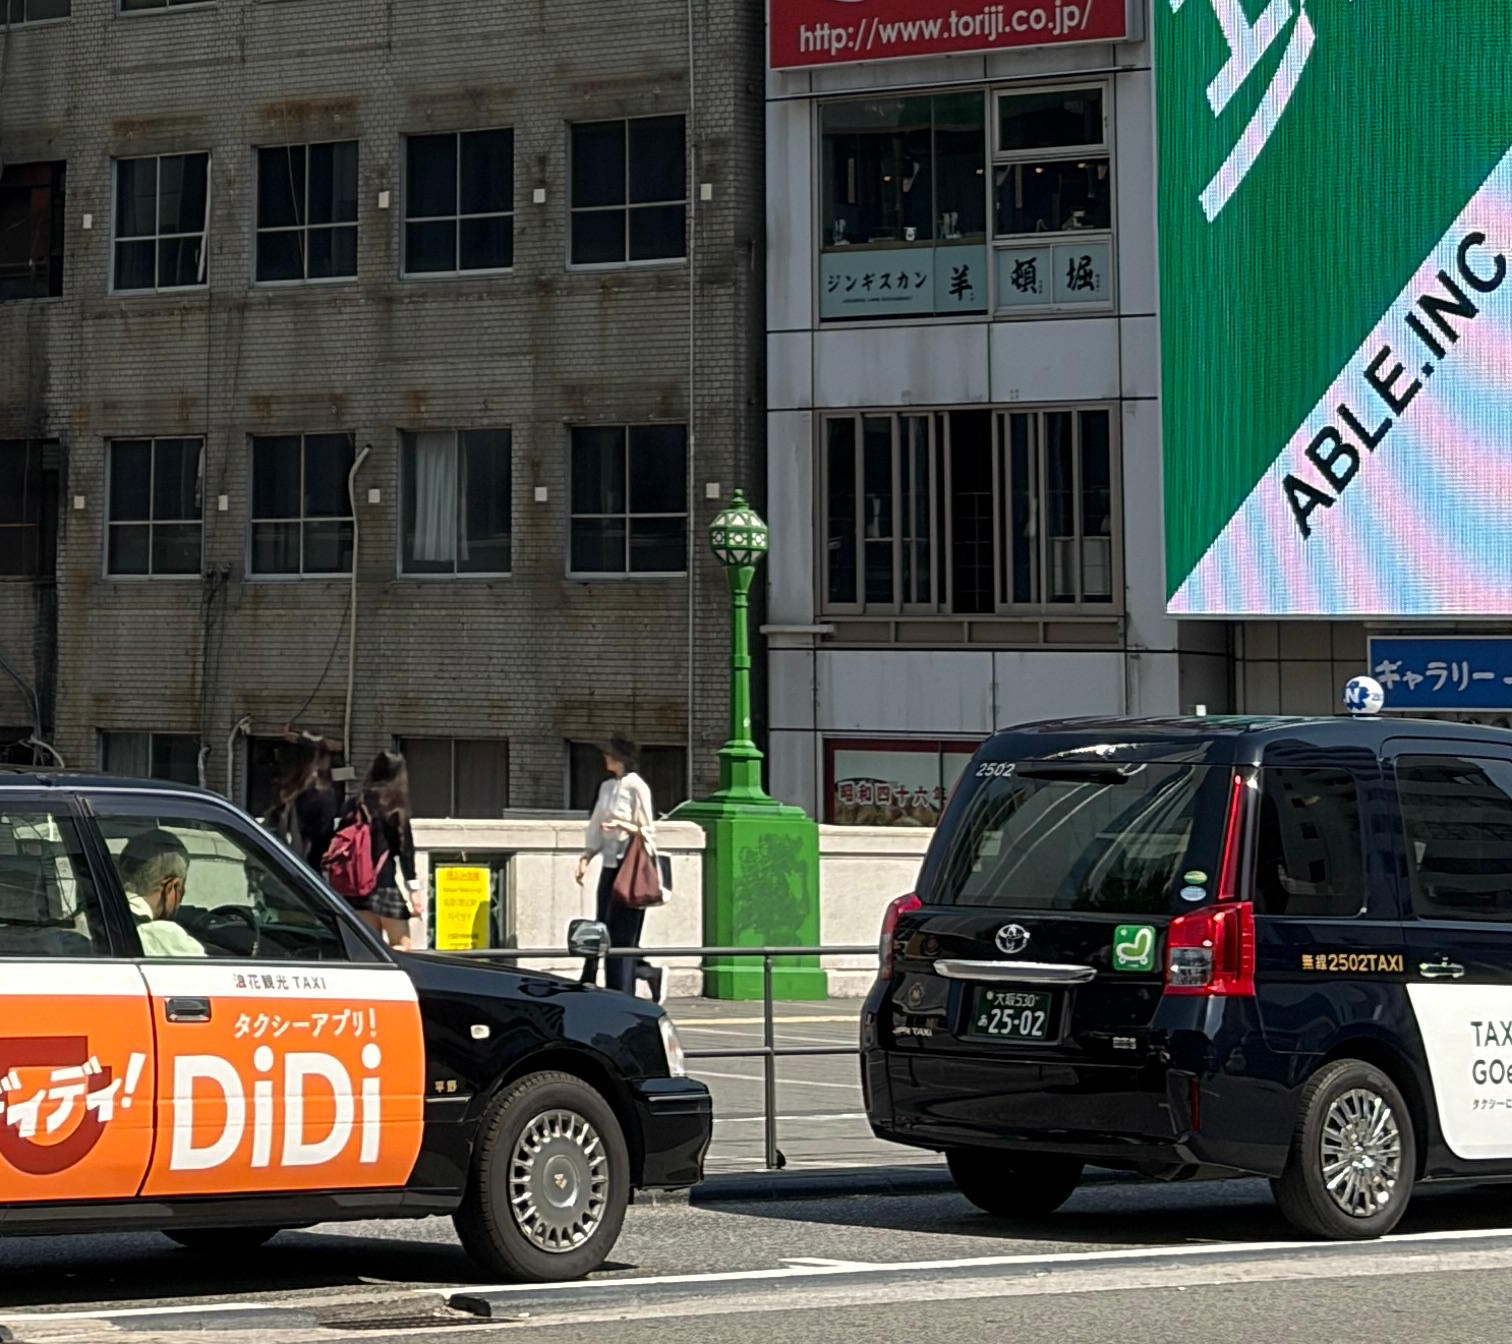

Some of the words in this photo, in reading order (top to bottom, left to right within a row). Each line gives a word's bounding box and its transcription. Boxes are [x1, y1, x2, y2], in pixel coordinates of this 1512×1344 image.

[827, 272, 927, 293] ジンギスカン
[1282, 231, 1506, 540] ABLE.INC
[1374, 660, 1512, 692] ギャラリー
[975, 762, 1016, 777] 2502
[295, 976, 327, 990] TAXI
[234, 1008, 377, 1038] タクシーアプリ!
[988, 1009, 1046, 1036] 25-02
[169, 1043, 381, 1170] DiDi
